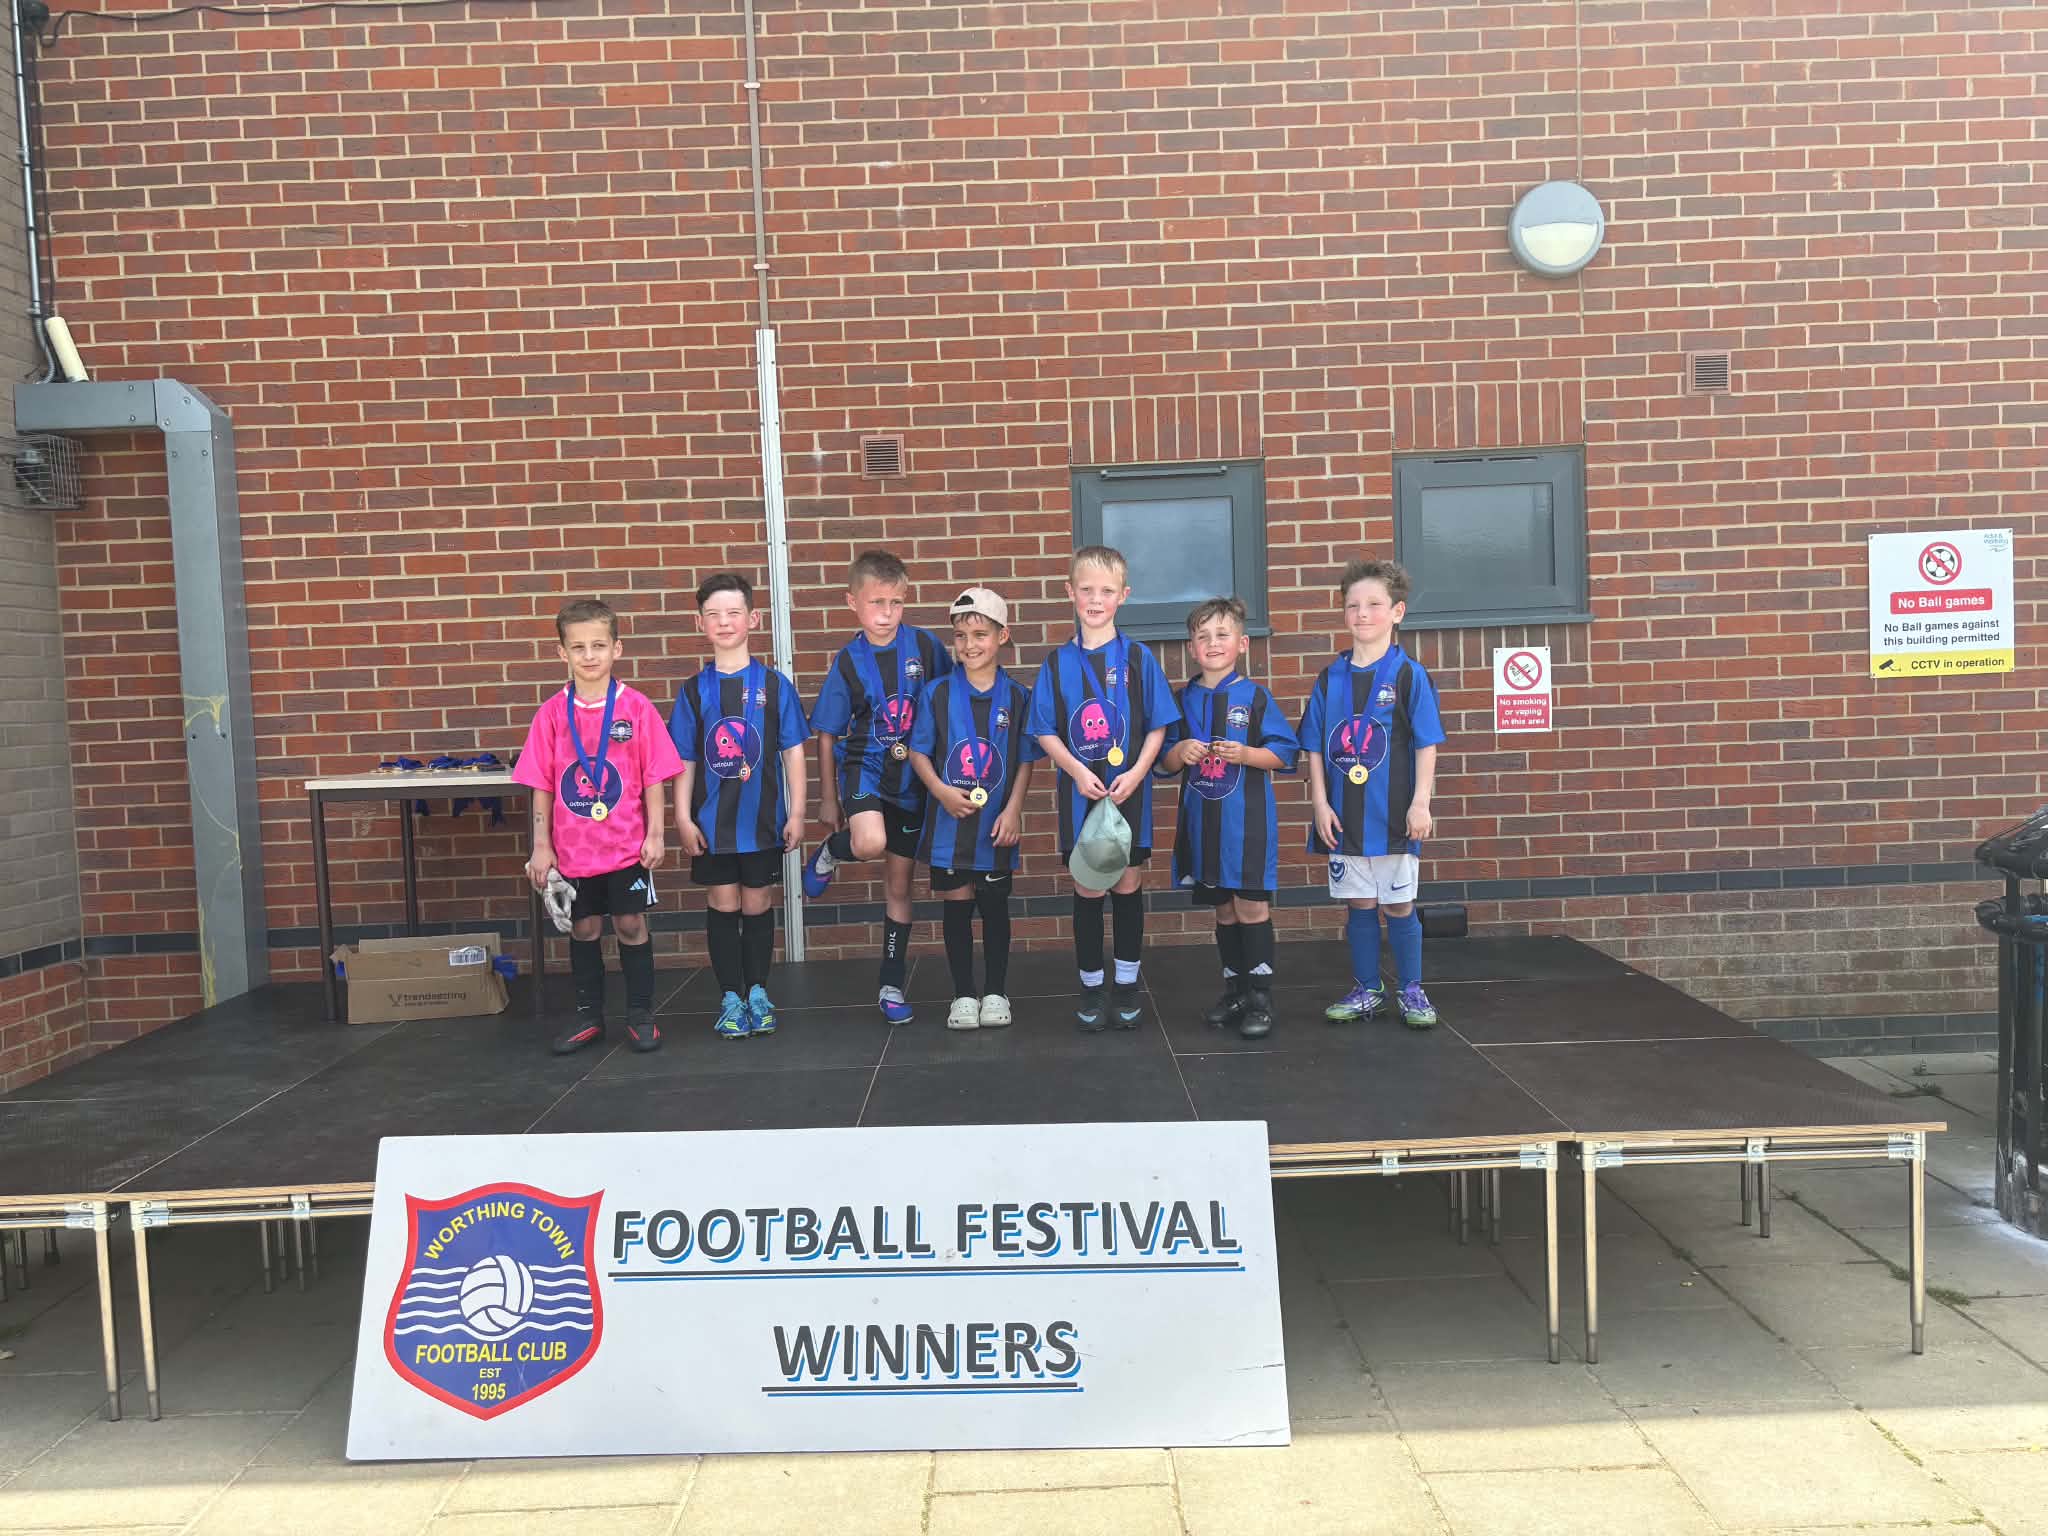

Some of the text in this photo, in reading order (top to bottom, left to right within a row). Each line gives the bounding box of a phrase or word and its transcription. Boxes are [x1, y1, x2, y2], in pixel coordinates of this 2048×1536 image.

[1898, 596, 1985, 609] No Ball games
[1884, 619, 2000, 633] No Ball games against
[1884, 632, 2000, 646] this building permitted
[1911, 658, 2005, 670] CCTV in operation
[1500, 698, 1547, 707] No smoking
[1516, 709, 1543, 717] vaping
[424, 1201, 576, 1260] WORTHING TOWN
[613, 1200, 1243, 1263] FOOTBALL FESTIVAL
[415, 1341, 567, 1364] FOOTBALL CLUB
[773, 1321, 1082, 1381] WINNERS
[479, 1367, 502, 1379] EST
[472, 1383, 506, 1401] 1995
